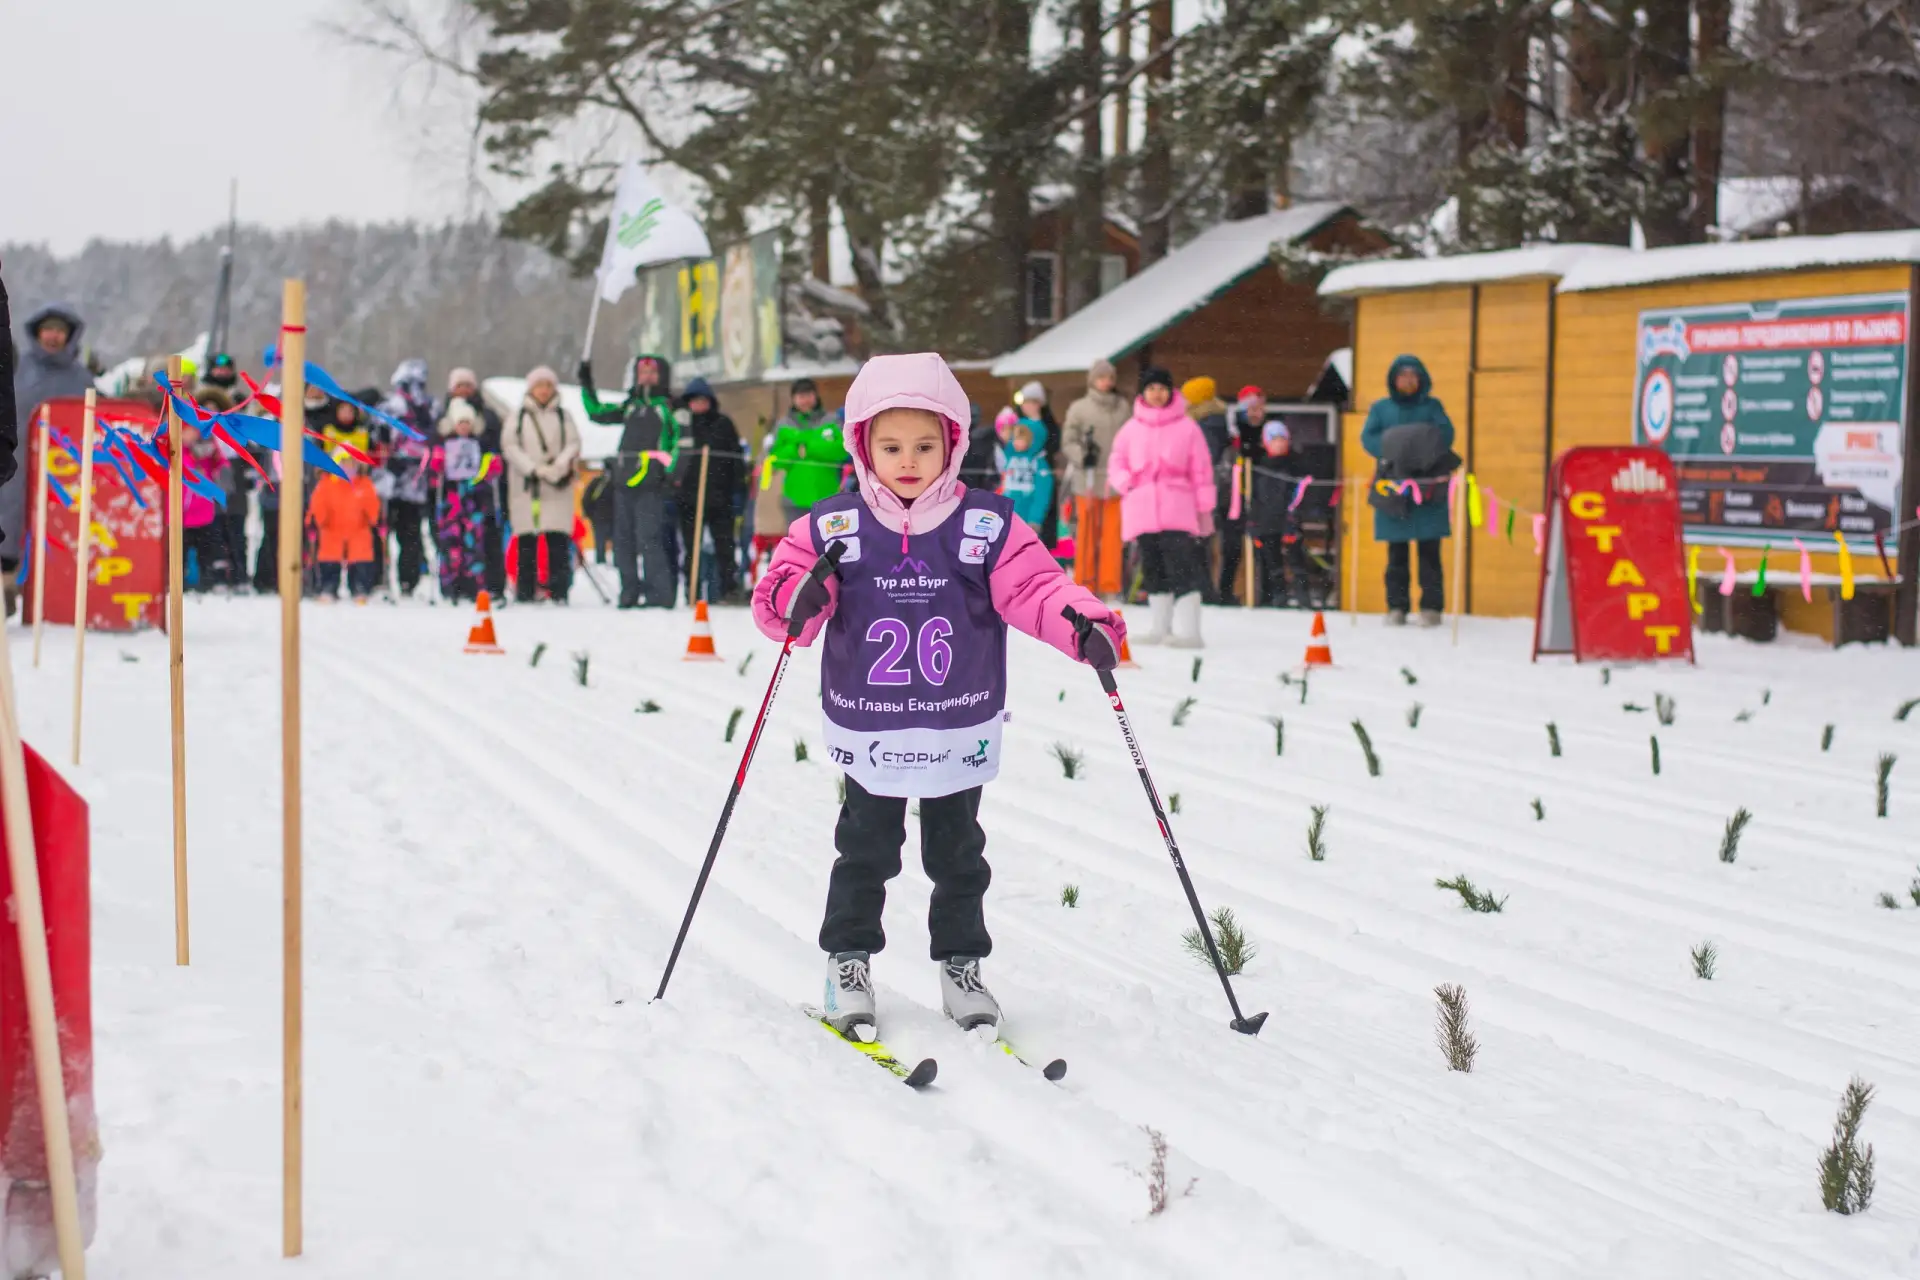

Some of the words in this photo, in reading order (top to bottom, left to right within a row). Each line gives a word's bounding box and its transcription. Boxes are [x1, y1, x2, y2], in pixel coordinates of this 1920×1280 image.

[874, 577, 897, 590] Тур
[900, 578, 916, 588] де
[918, 576, 949, 589] Бург
[1569, 491, 1681, 654] СТАРТ
[866, 616, 953, 686] 26
[829, 688, 856, 709] Кубок
[859, 698, 903, 713] Главы
[908, 690, 990, 712] Екатеринбурга
[882, 749, 951, 763] СТОРИНГ
[1116, 713, 1142, 766] NORDWAY
